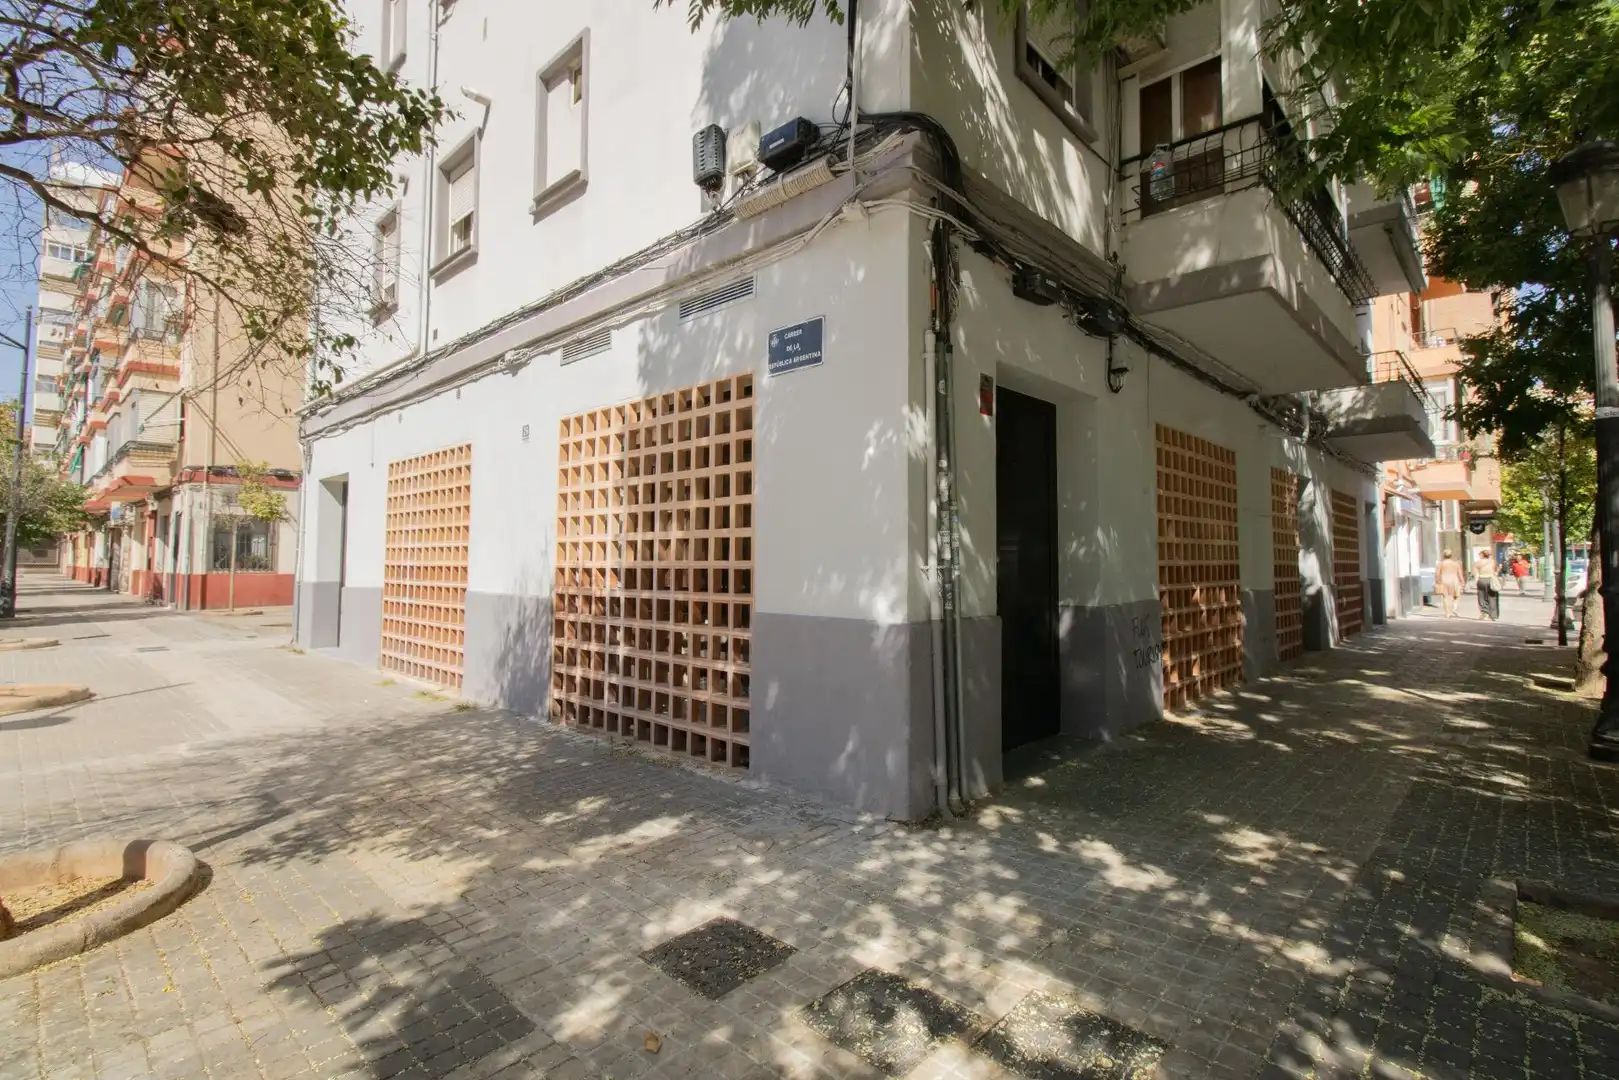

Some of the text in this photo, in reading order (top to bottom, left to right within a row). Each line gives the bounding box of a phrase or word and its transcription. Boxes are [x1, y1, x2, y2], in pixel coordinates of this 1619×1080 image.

[784, 329, 802, 340] CARRER
[793, 343, 800, 351] LA
[793, 350, 821, 363] ARGENTINA
